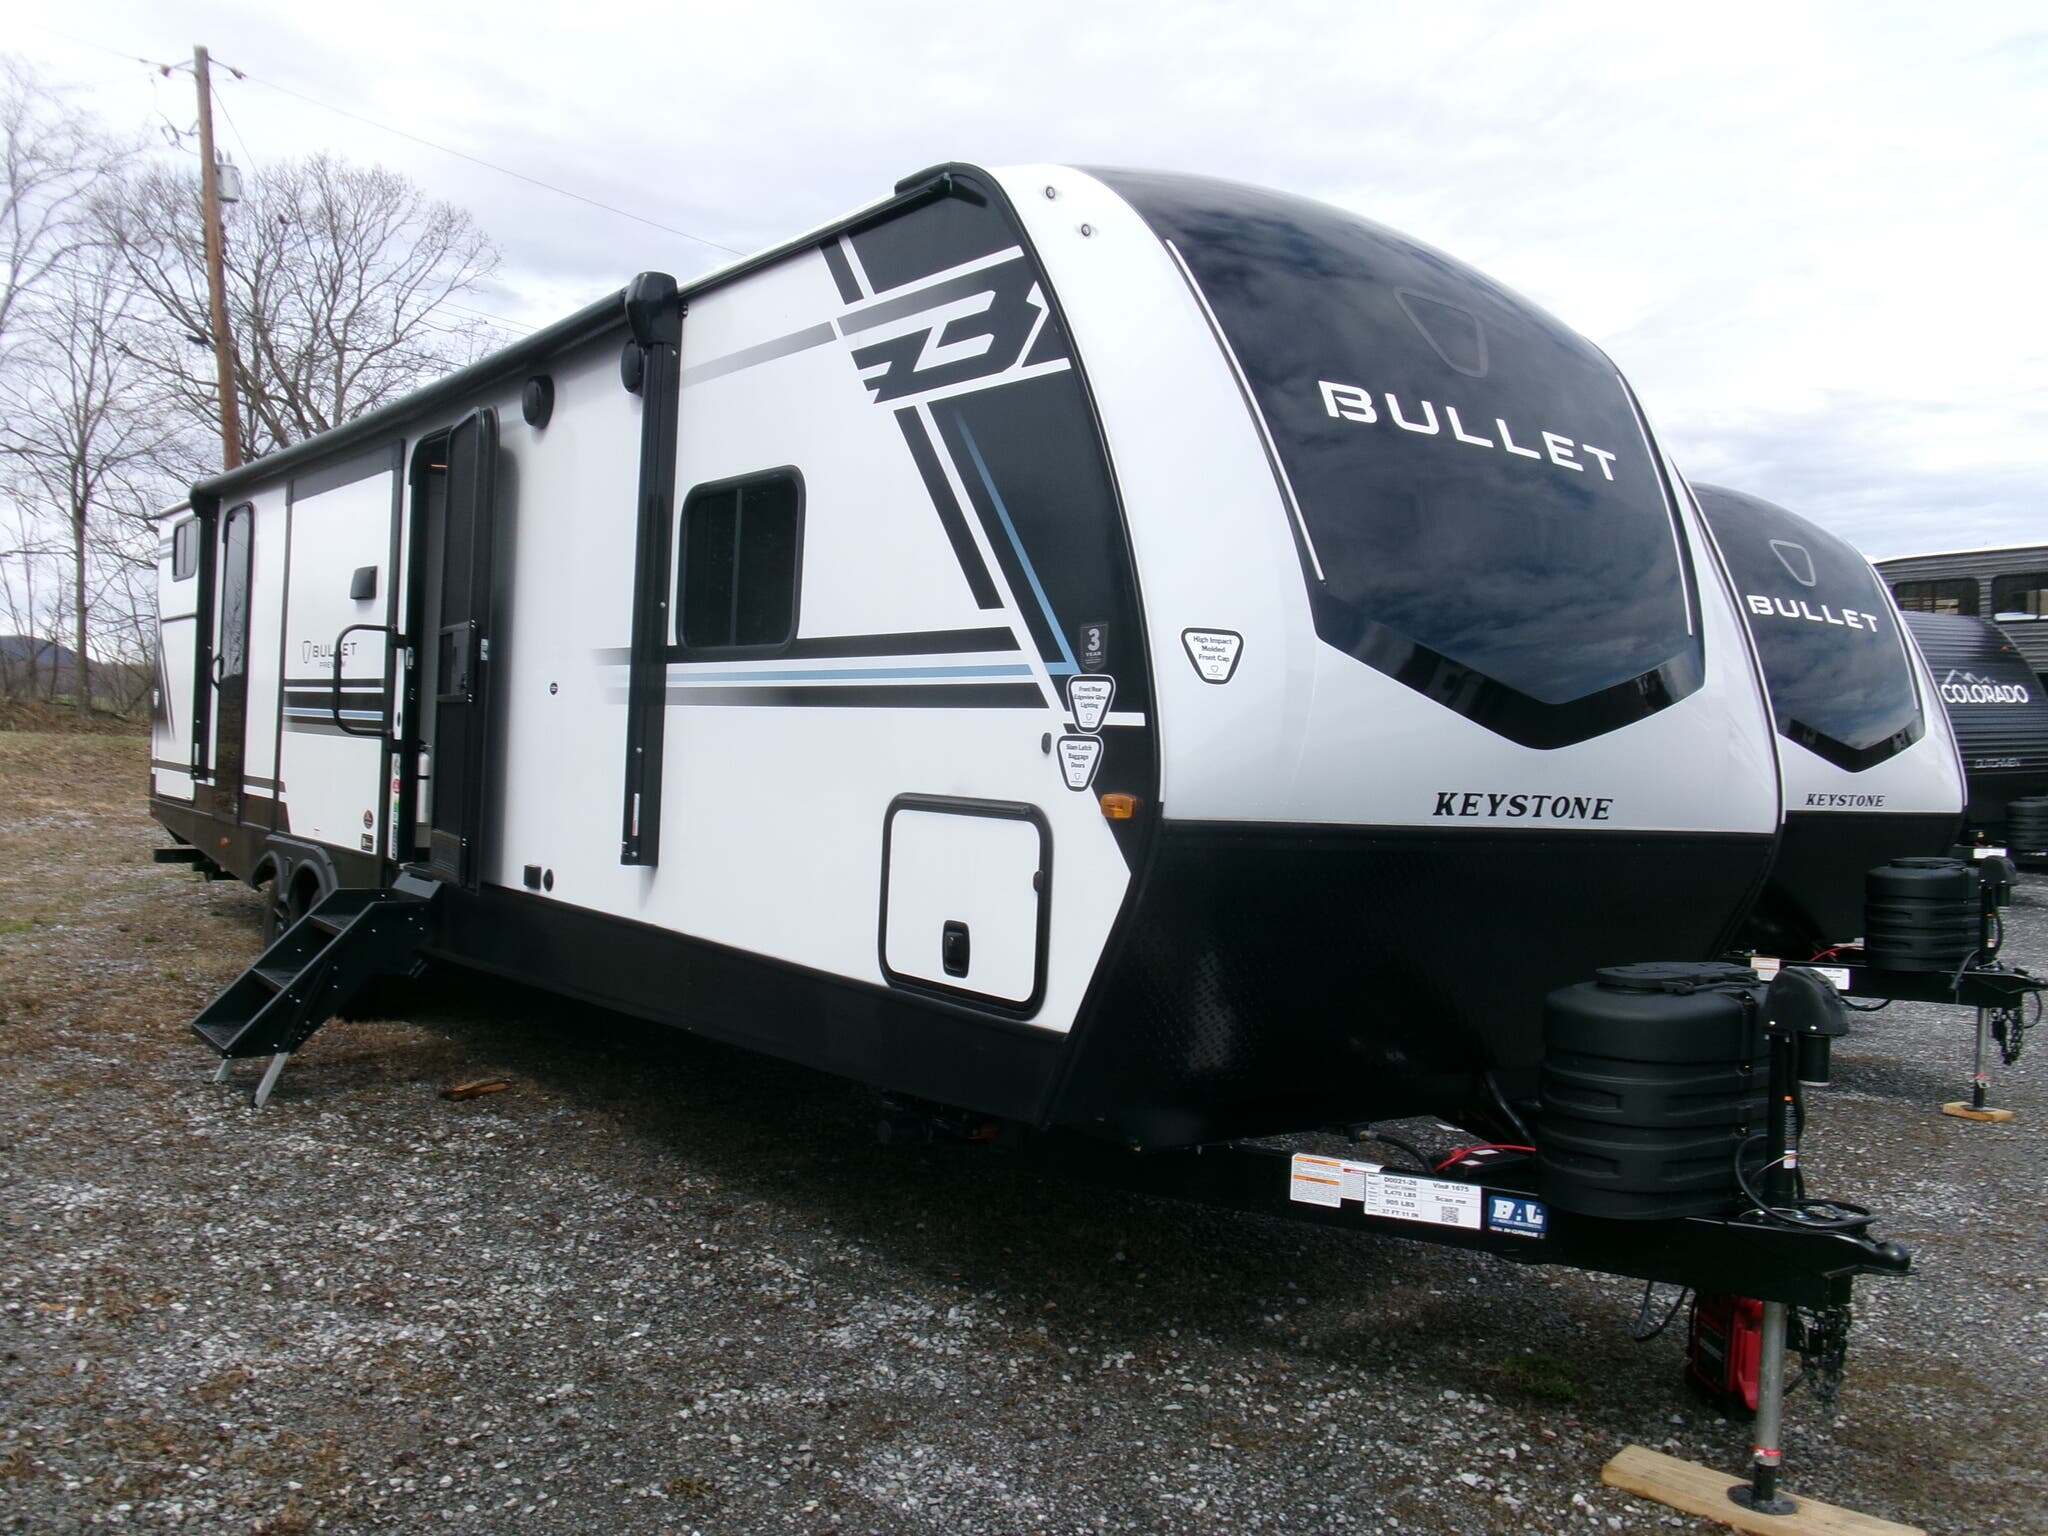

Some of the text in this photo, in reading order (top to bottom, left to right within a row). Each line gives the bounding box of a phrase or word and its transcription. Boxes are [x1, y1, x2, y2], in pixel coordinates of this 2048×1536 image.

[1318, 380, 1617, 481] BULLET
[1746, 595, 1878, 633] BULLET
[1088, 628, 1100, 651] 3
[1193, 636, 1233, 645] High Impact
[313, 643, 358, 657] BULET
[1198, 653, 1216, 661] Front
[1941, 684, 2029, 703] COLORADO
[1433, 792, 1615, 820] KEYSTONE
[1806, 793, 1886, 807] KEYSTONE
